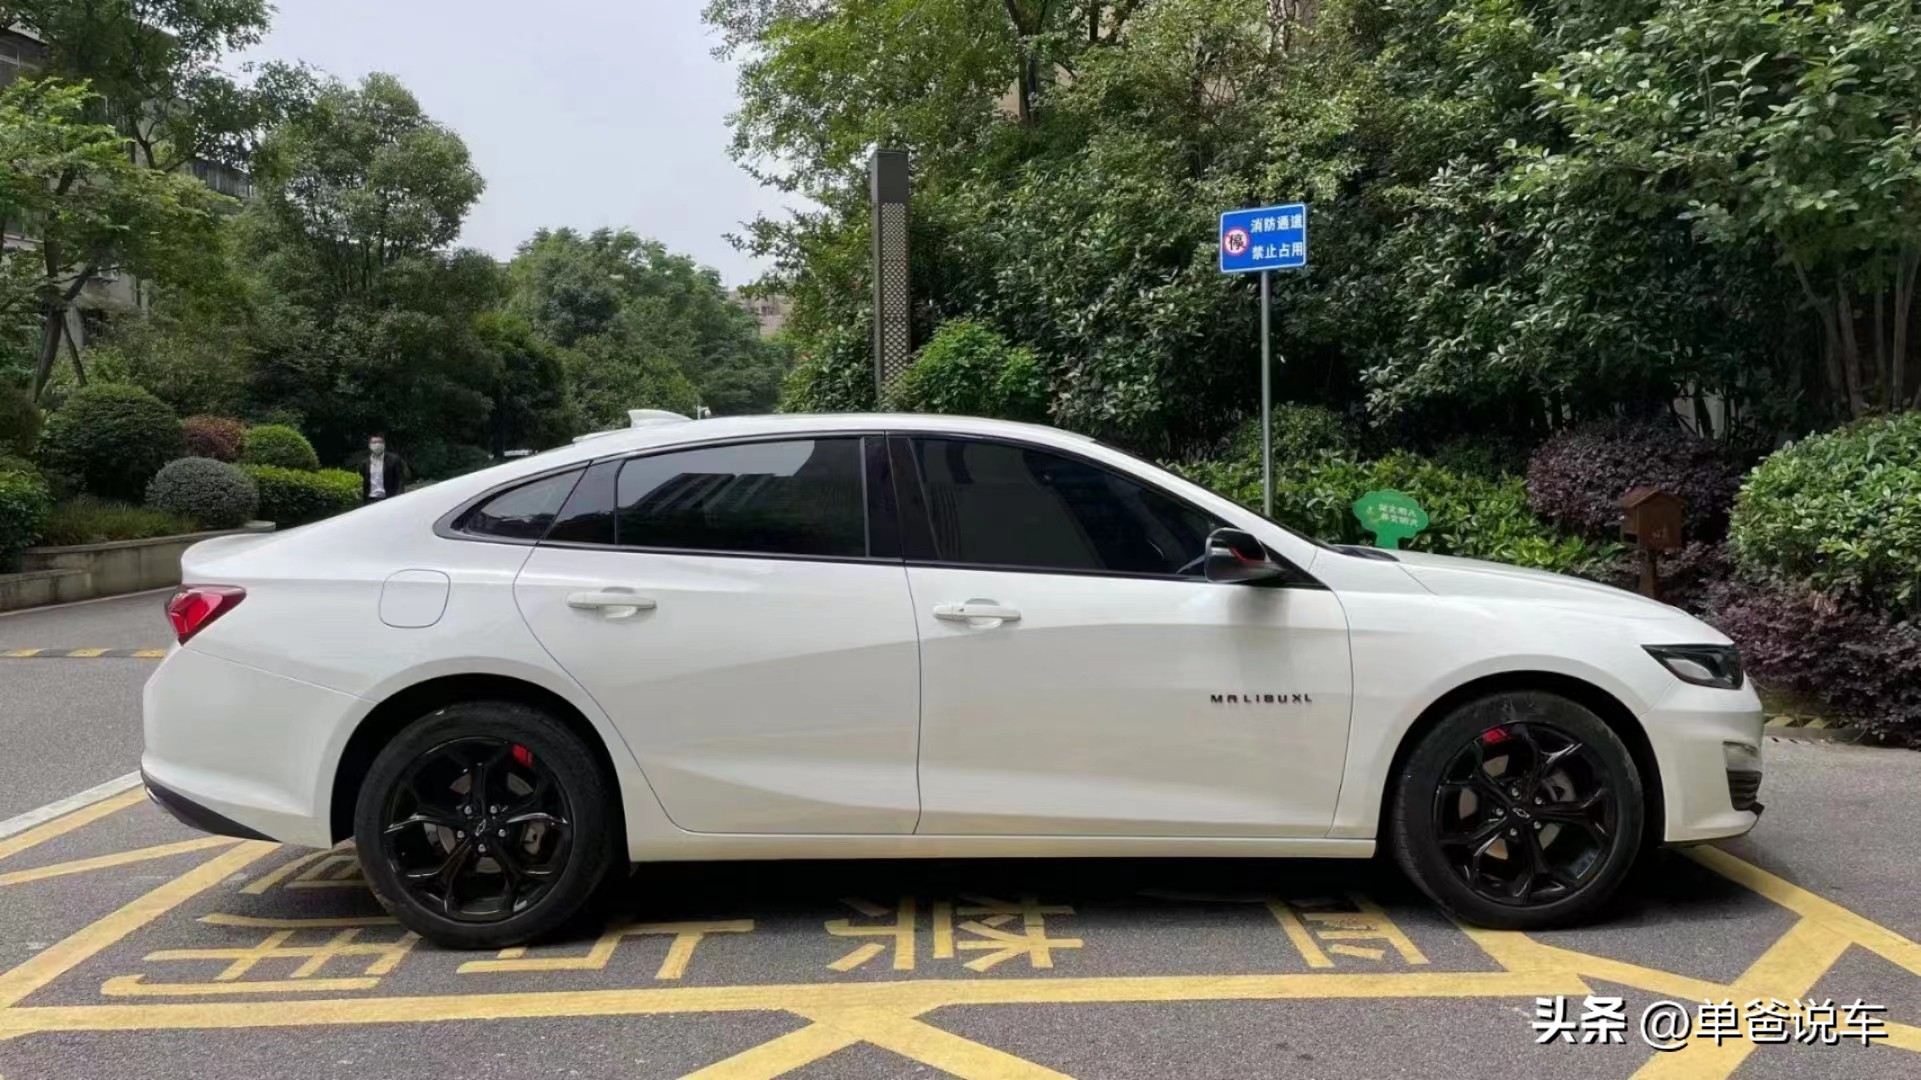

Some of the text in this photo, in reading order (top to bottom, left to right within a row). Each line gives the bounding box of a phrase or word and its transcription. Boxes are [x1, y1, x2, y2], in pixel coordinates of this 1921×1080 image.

[1250, 213, 1303, 233] 消防通道
[1252, 241, 1304, 260] 禁止占用
